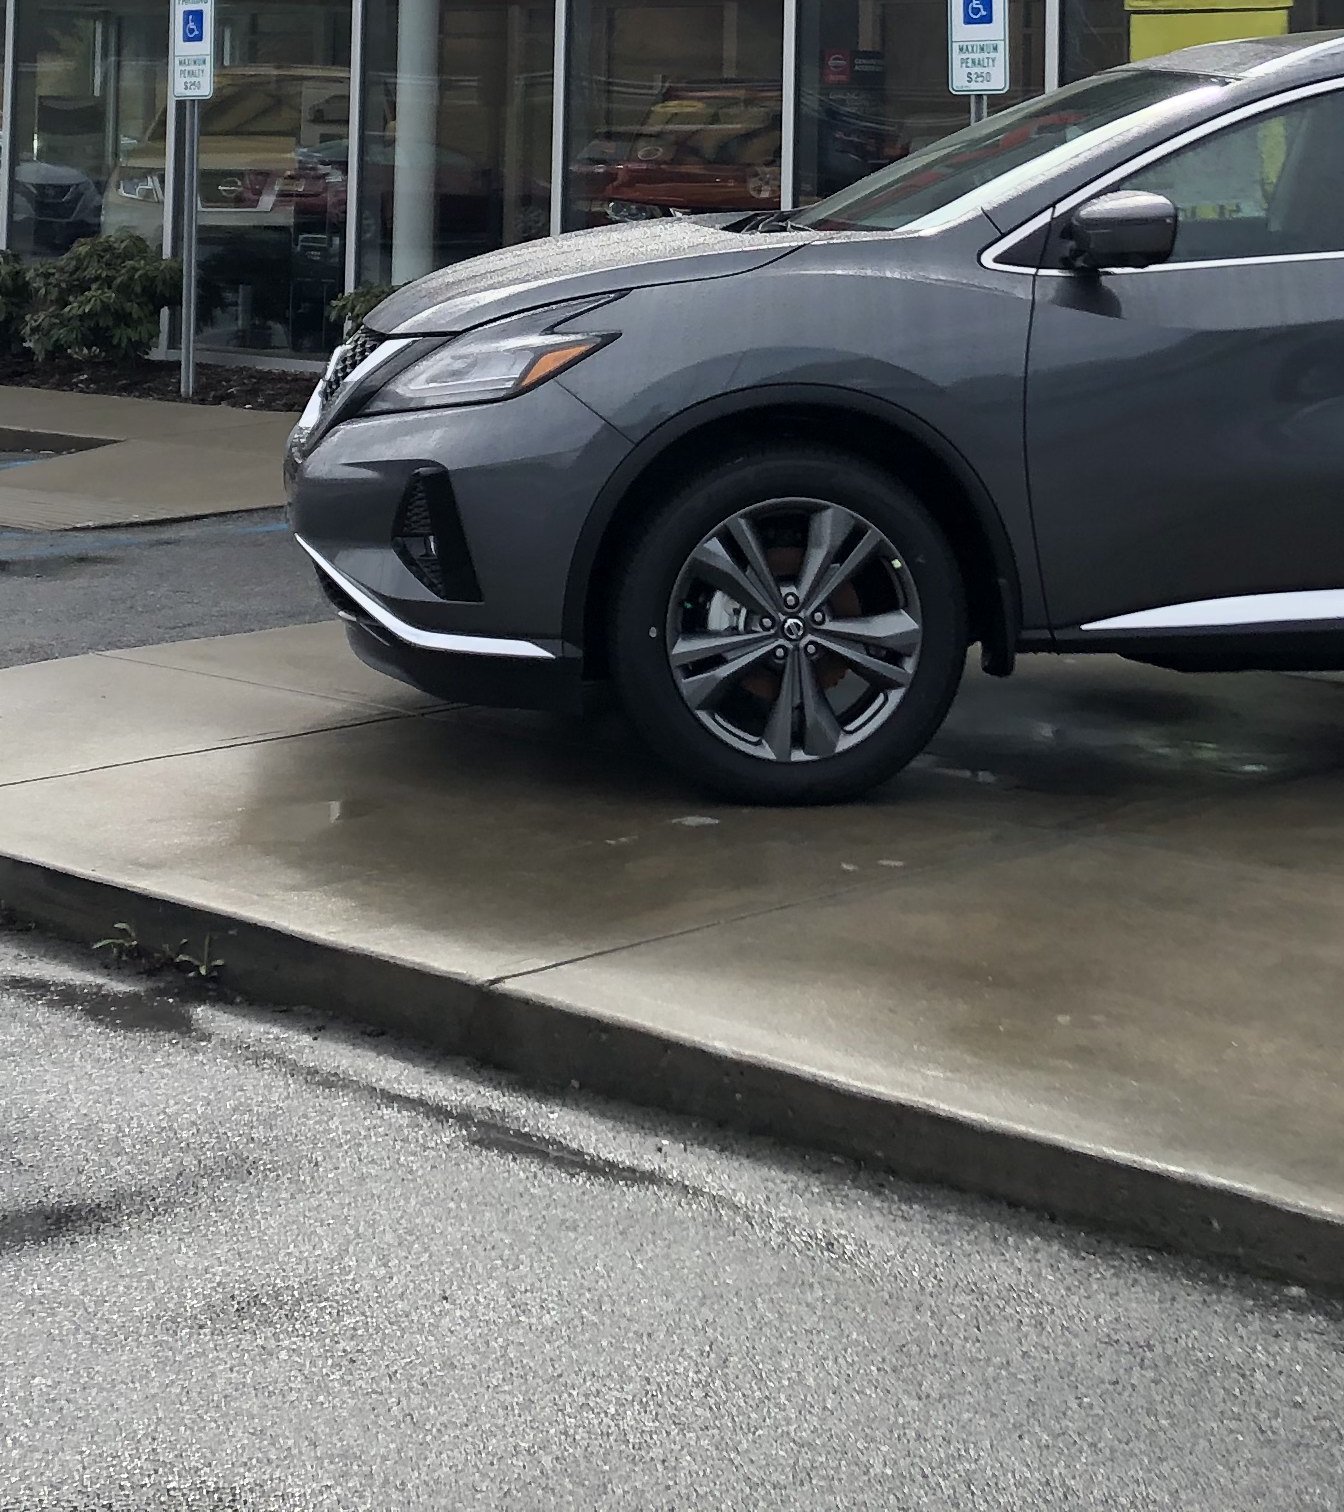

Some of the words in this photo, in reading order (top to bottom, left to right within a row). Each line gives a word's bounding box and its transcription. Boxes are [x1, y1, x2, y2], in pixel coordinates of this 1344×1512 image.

[958, 43, 998, 54] MAXIMUM
[178, 57, 207, 67] MAXIMUM
[960, 57, 996, 69] PENALTY
[179, 68, 205, 79] PENALTY
[966, 71, 991, 84] $250
